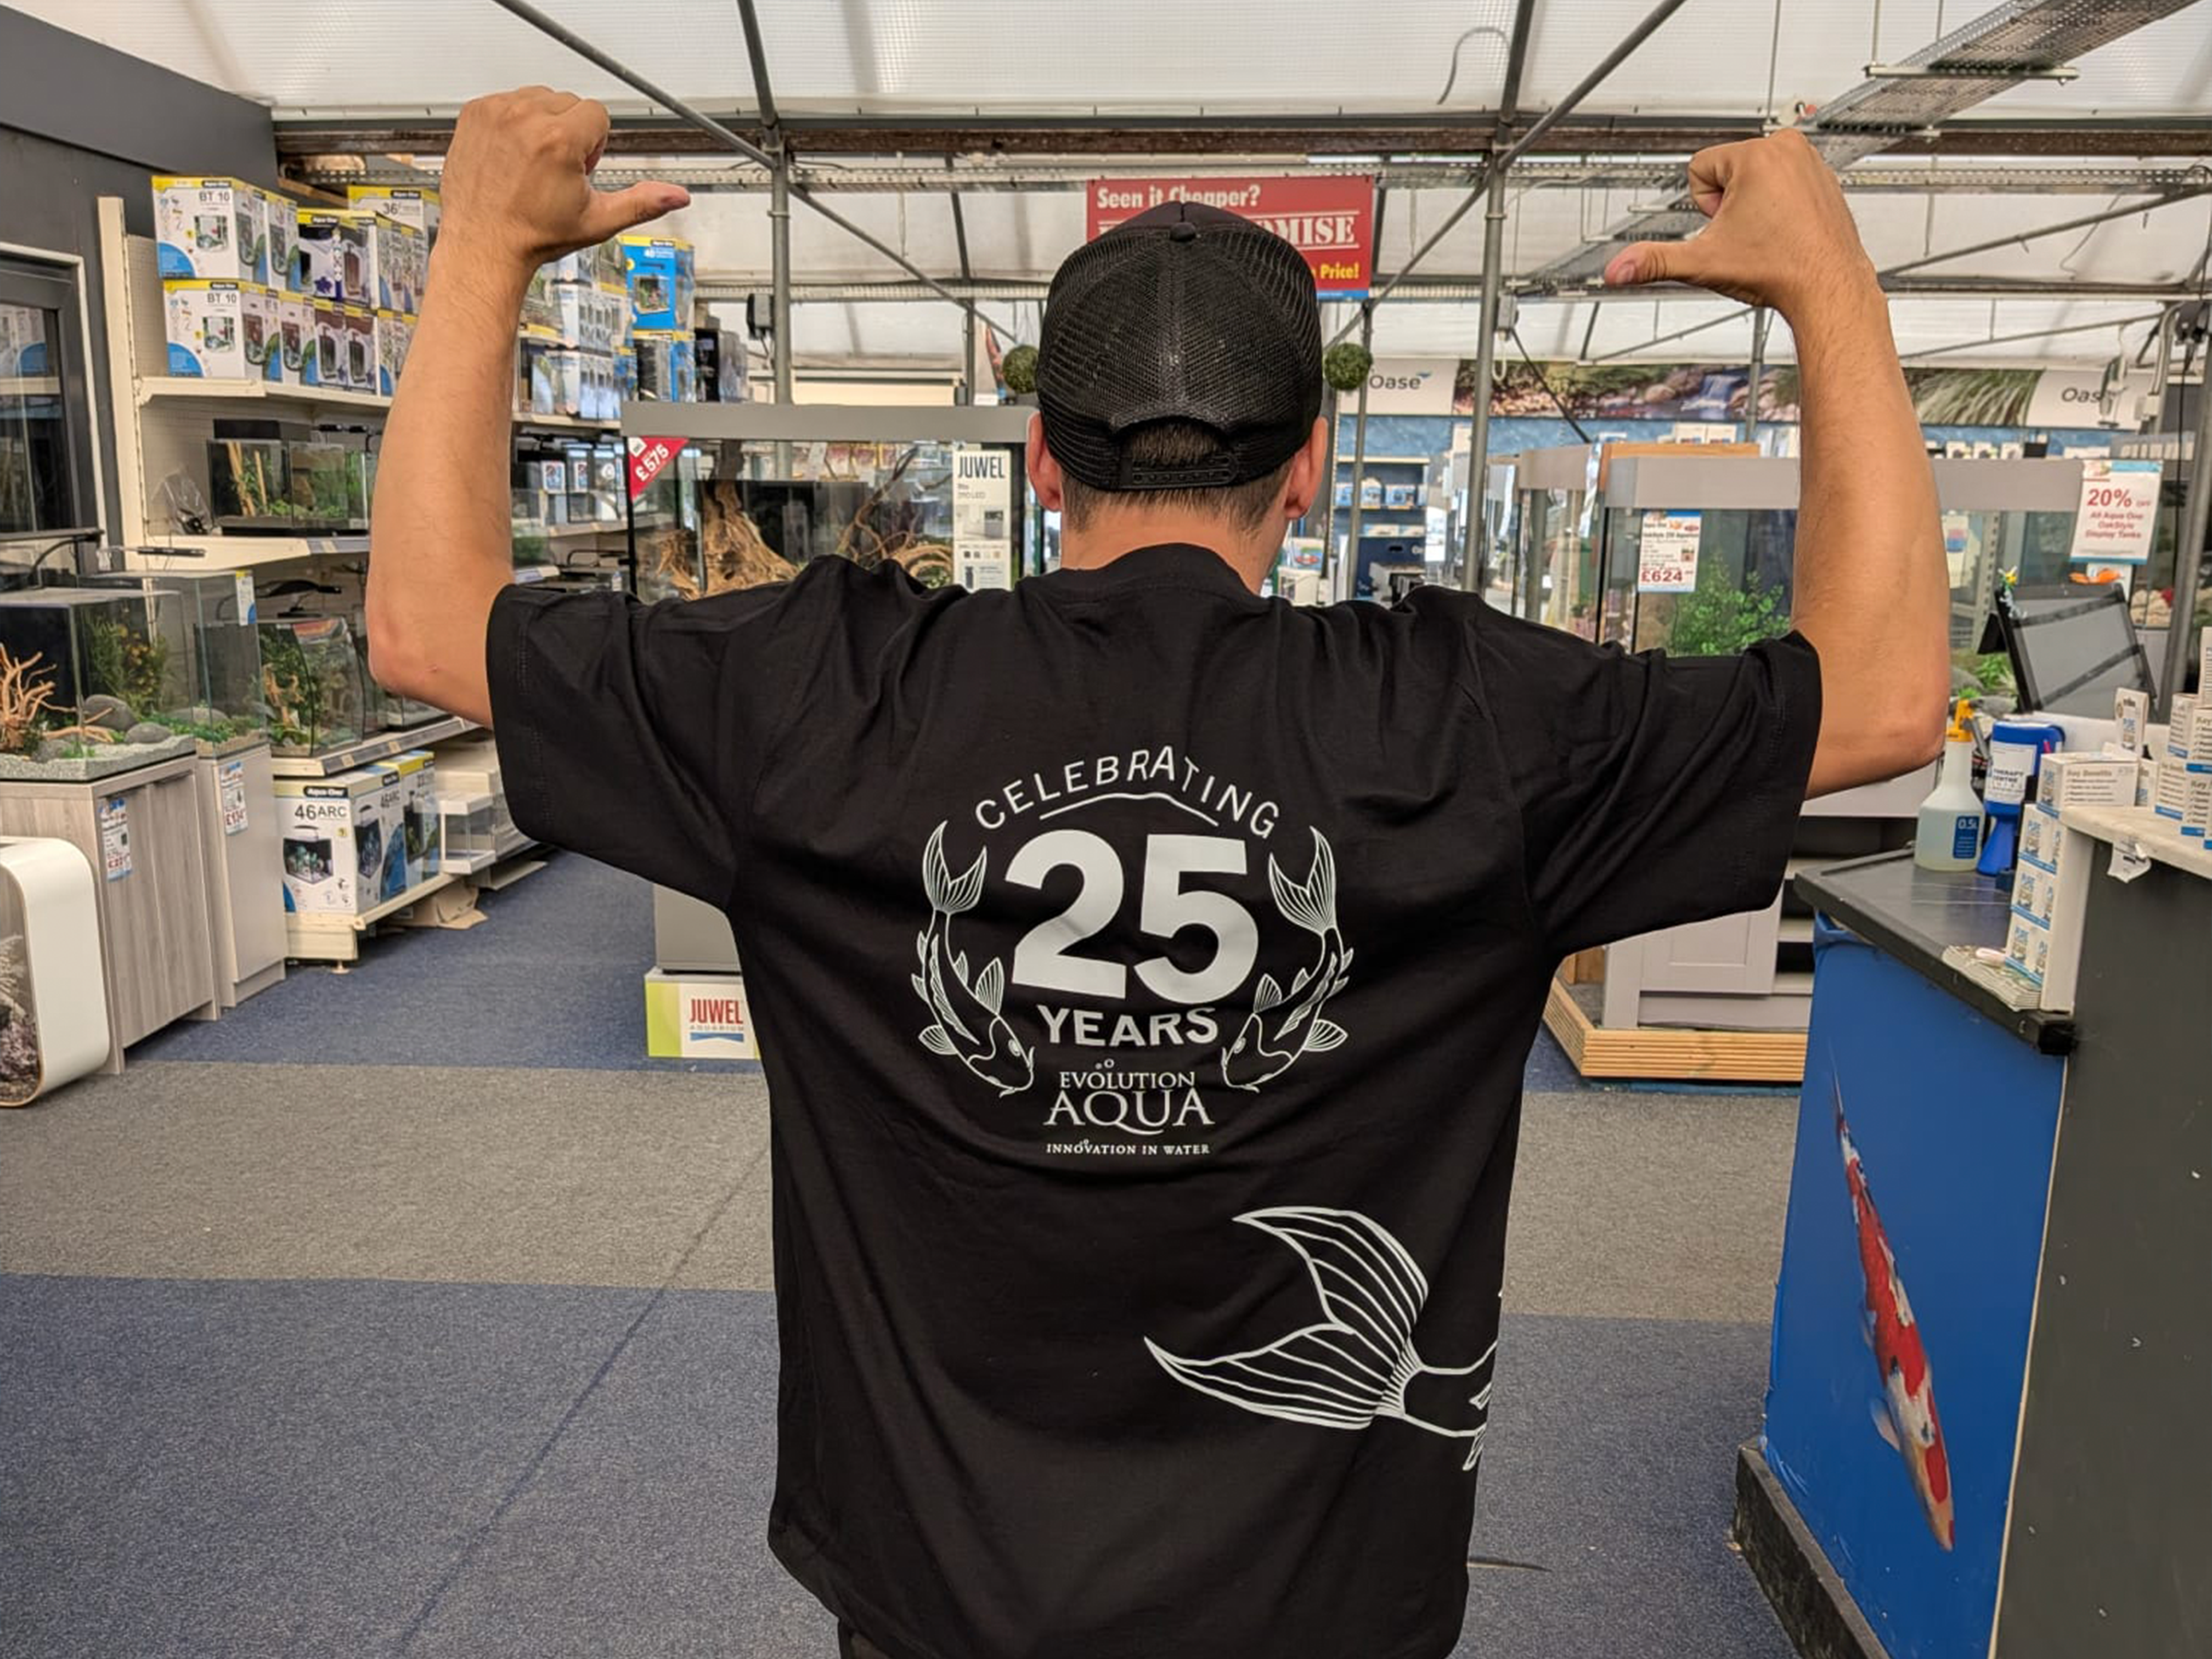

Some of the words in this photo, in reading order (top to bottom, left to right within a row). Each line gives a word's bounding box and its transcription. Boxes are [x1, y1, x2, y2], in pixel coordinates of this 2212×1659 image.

[199, 191, 213, 201] BT
[218, 191, 230, 201] 10
[1098, 187, 1143, 208] Seen
[1149, 184, 1164, 207] it
[1169, 184, 1261, 207] Cheaper?
[1261, 216, 1355, 246] MISE
[1321, 261, 1359, 279] Price!
[207, 292, 221, 303] BT
[225, 292, 236, 303] 10
[1369, 375, 1421, 390] Oase
[957, 456, 1005, 479] JUWEL
[2086, 488, 2132, 508] 20%
[2103, 512, 2124, 521] Aqua
[1641, 569, 1683, 582] £624
[975, 745, 1280, 839] CELEBRATING
[1005, 829, 1259, 1004] 25
[689, 998, 744, 1025] JUWEL
[1037, 1004, 1218, 1047] YEARS
[1059, 1071, 1195, 1090] EVOLUTION
[1043, 1087, 1216, 1136] AQUA
[1046, 1143, 1137, 1155] INNOVATION
[1142, 1144, 1158, 1155] IN
[1163, 1144, 1210, 1156] WATER
